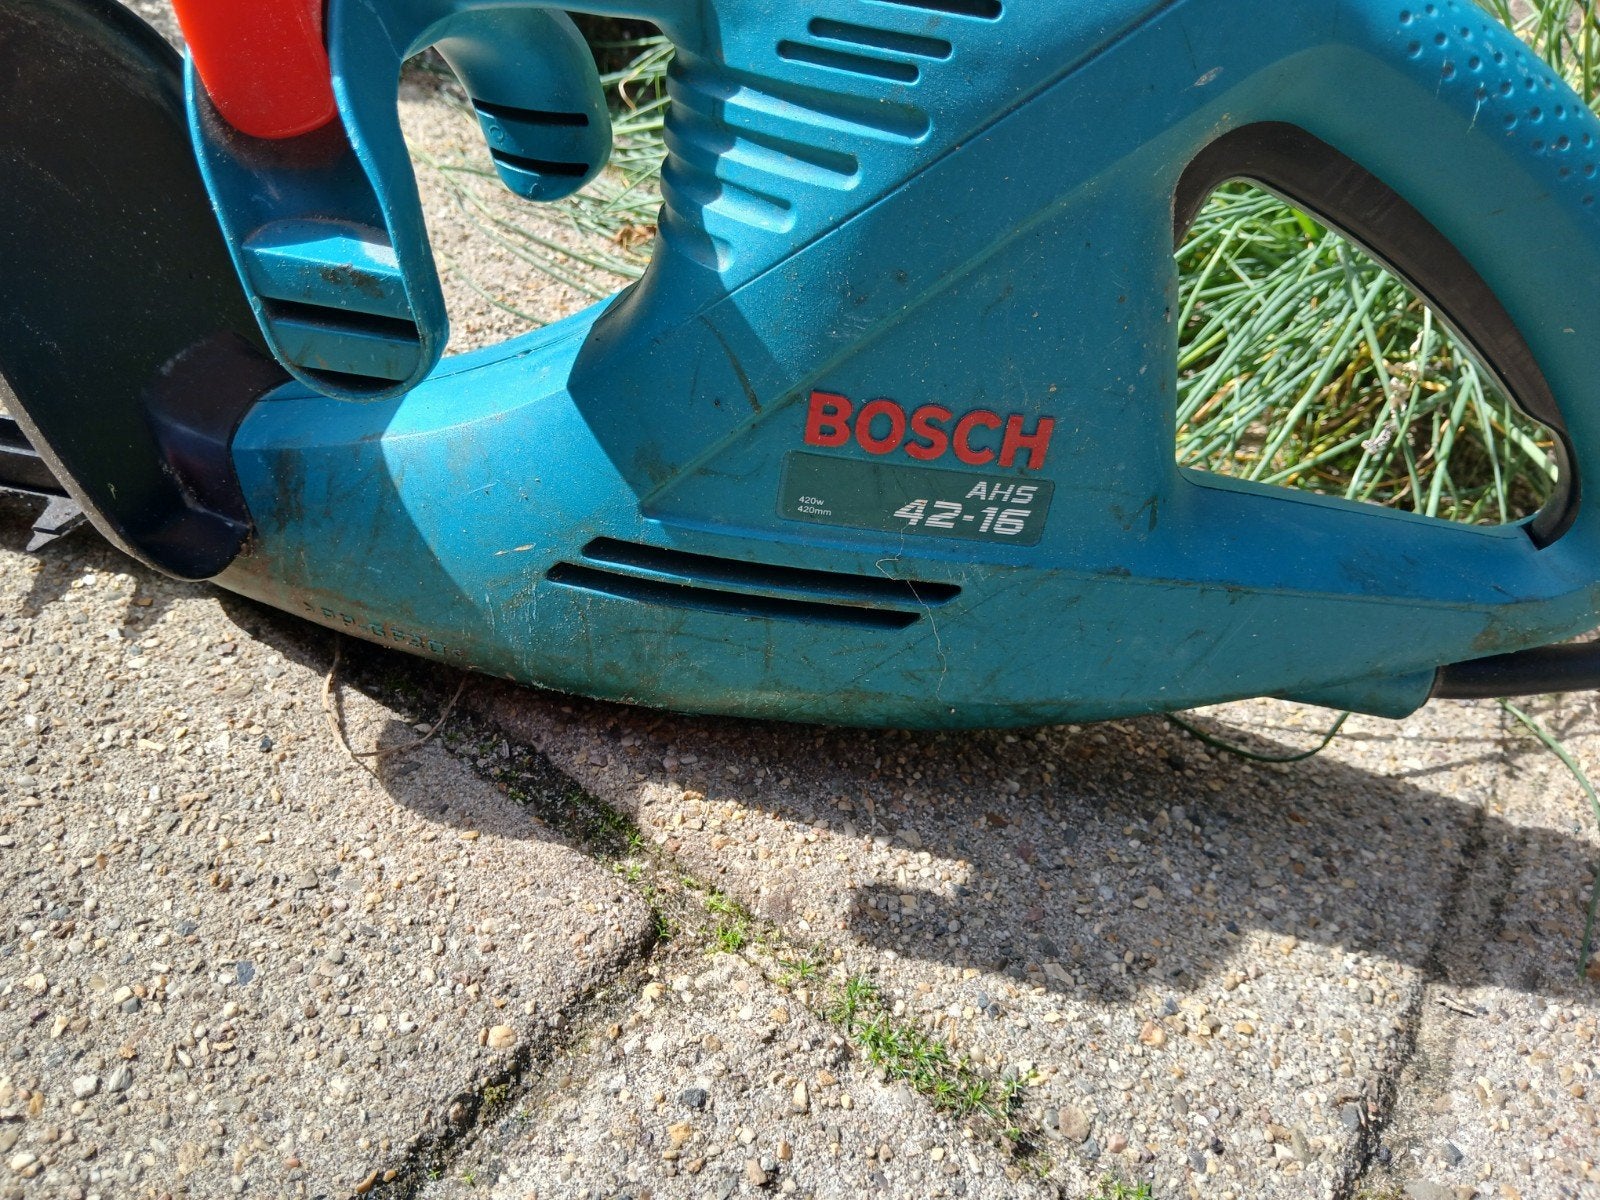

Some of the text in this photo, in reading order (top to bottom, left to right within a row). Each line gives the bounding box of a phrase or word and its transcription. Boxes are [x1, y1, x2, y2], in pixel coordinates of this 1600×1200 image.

[804, 390, 1055, 470] BOSCH
[965, 481, 1038, 504] AHS
[797, 505, 832, 516] 420mm
[893, 499, 1031, 536] 42-16
